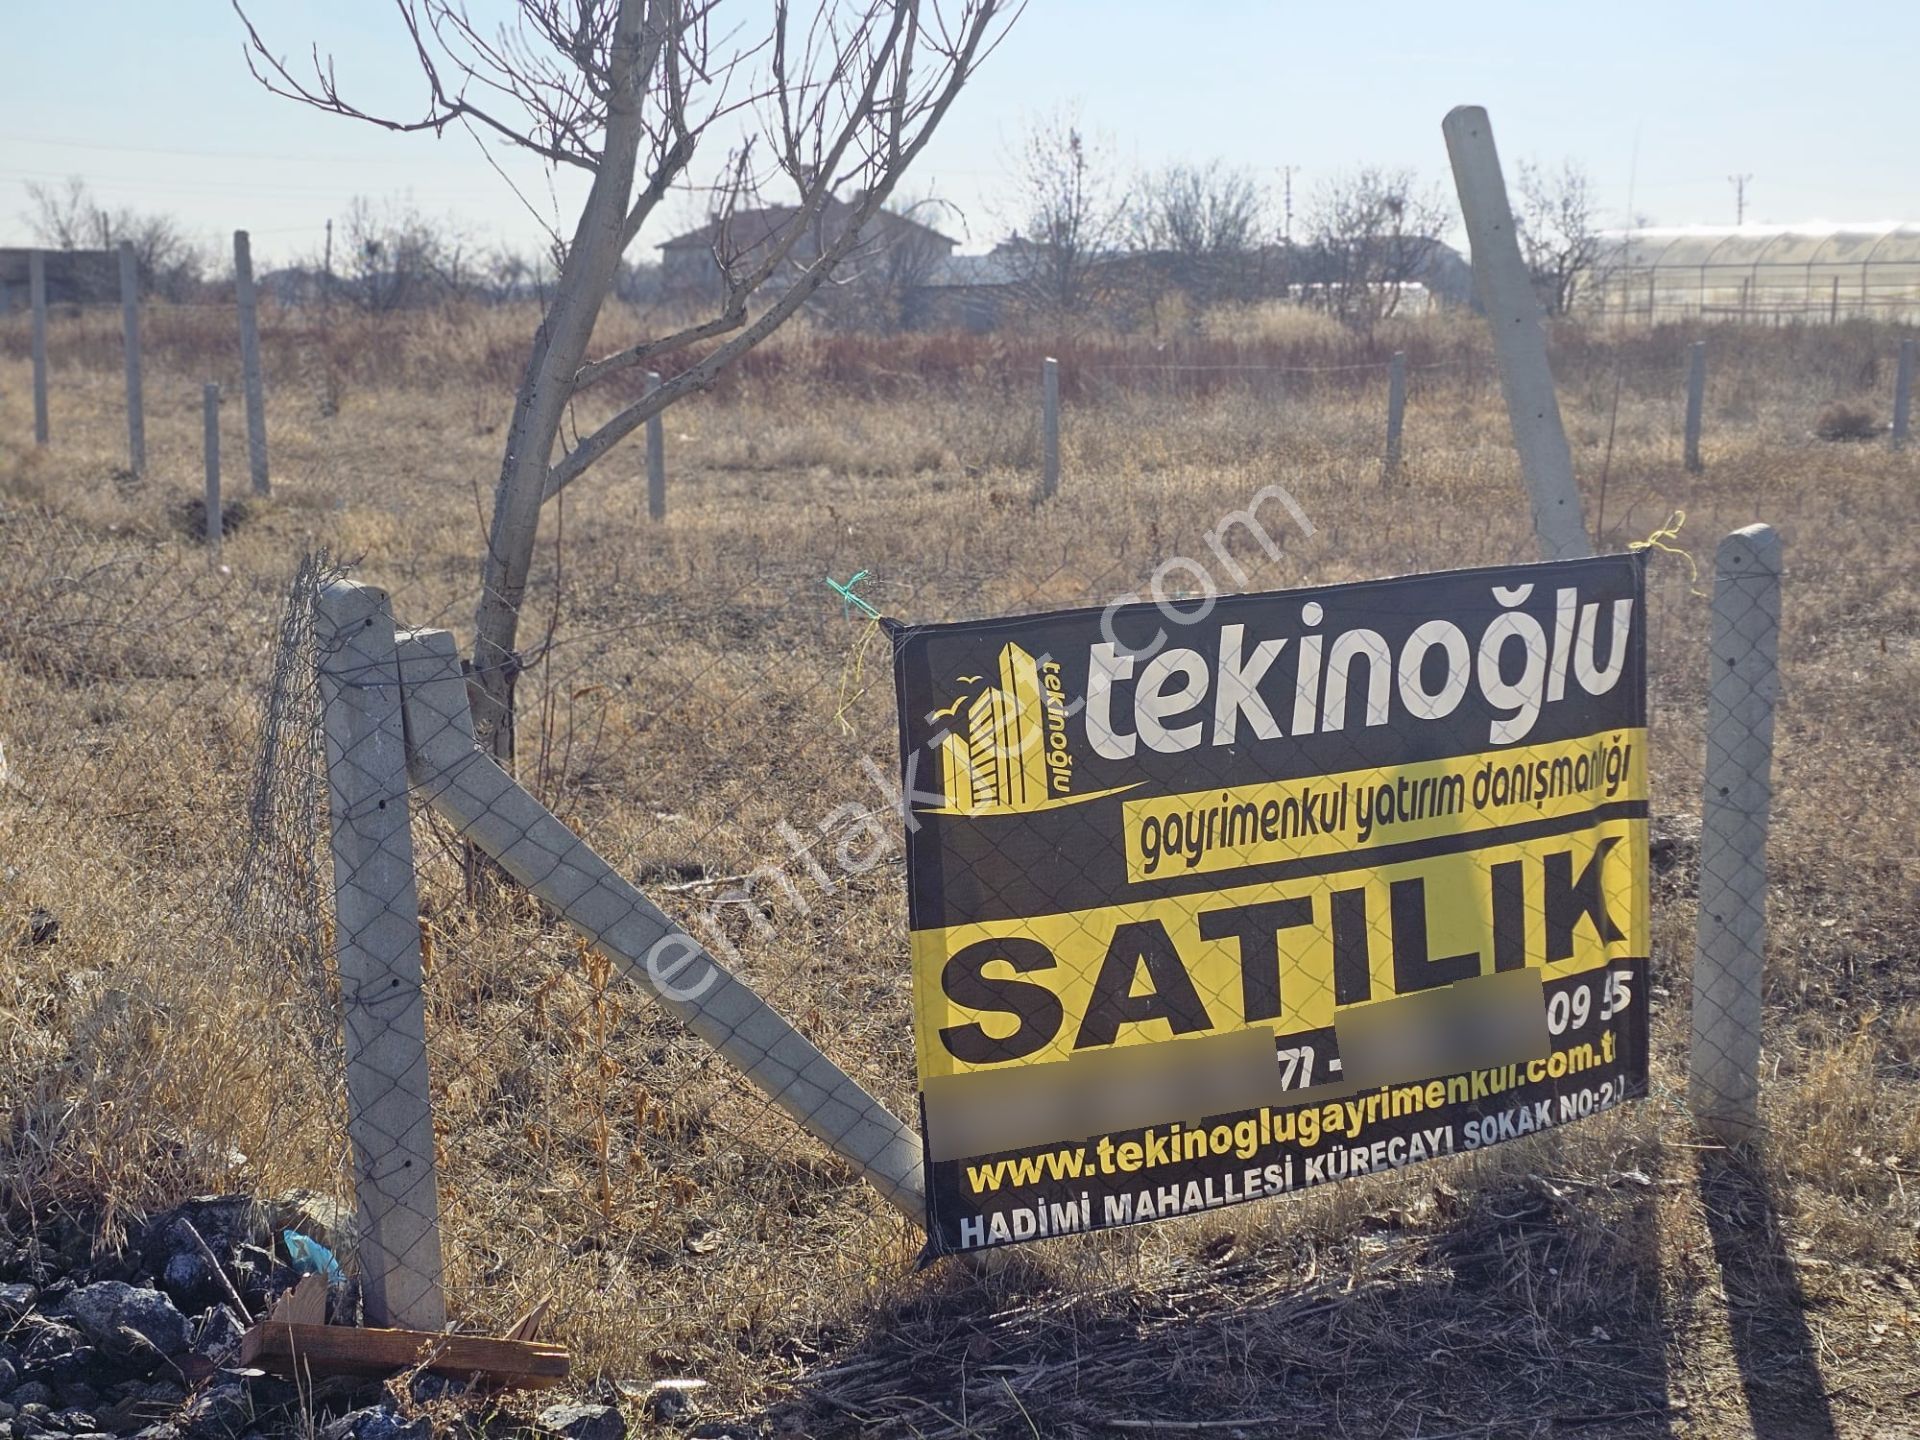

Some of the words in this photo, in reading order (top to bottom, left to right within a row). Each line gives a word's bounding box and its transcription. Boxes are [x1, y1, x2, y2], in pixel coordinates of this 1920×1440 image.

[1043, 661, 1073, 792] tekinoğlu
[1085, 584, 1633, 760] tekinoğlu
[1140, 782, 1348, 874] gayrimenkul
[1356, 773, 1465, 838] yatırım
[938, 836, 1628, 1065] SATILIK
[1547, 985, 1591, 1035] 09
[960, 1191, 1092, 1249] HADİMİ
[1104, 1155, 1293, 1227] MAHALLESİ
[1463, 1099, 1552, 1150] SOKAK
[967, 1029, 1617, 1194] www.tekinoglugayrimenkul.com.t
